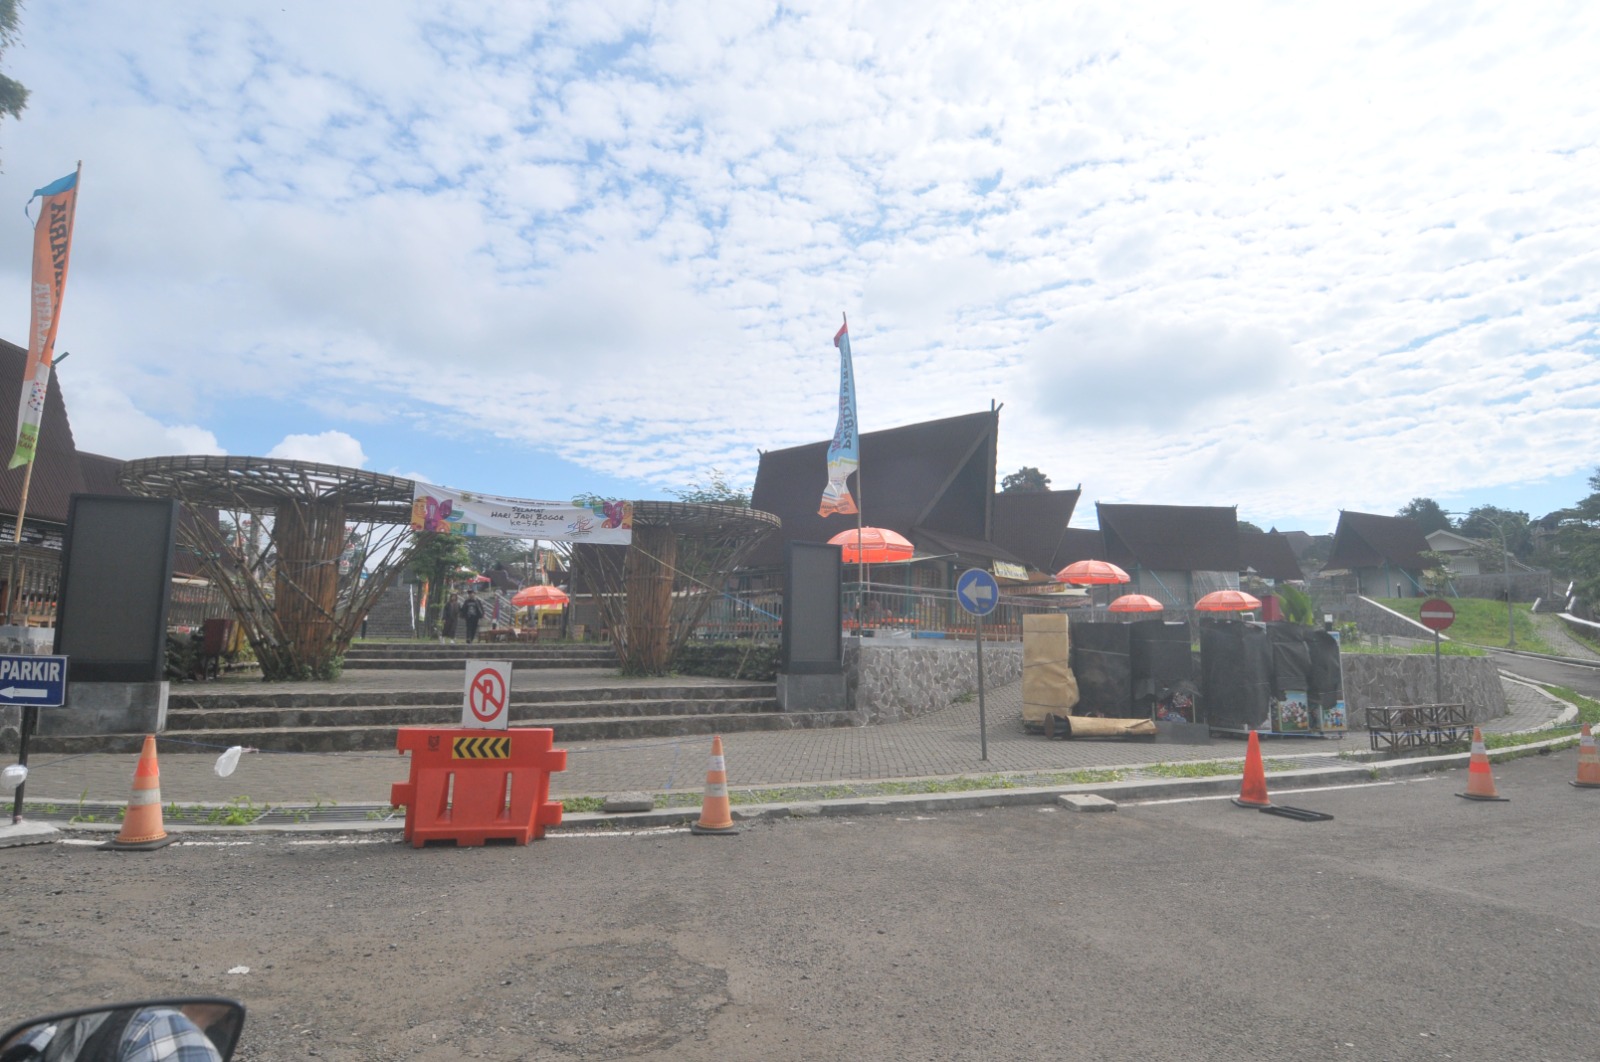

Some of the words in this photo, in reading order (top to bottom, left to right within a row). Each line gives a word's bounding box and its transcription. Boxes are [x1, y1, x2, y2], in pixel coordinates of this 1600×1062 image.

[490, 511, 511, 519] HARI
[536, 513, 565, 521] BOGOR
[0, 660, 60, 682] PARKIR
